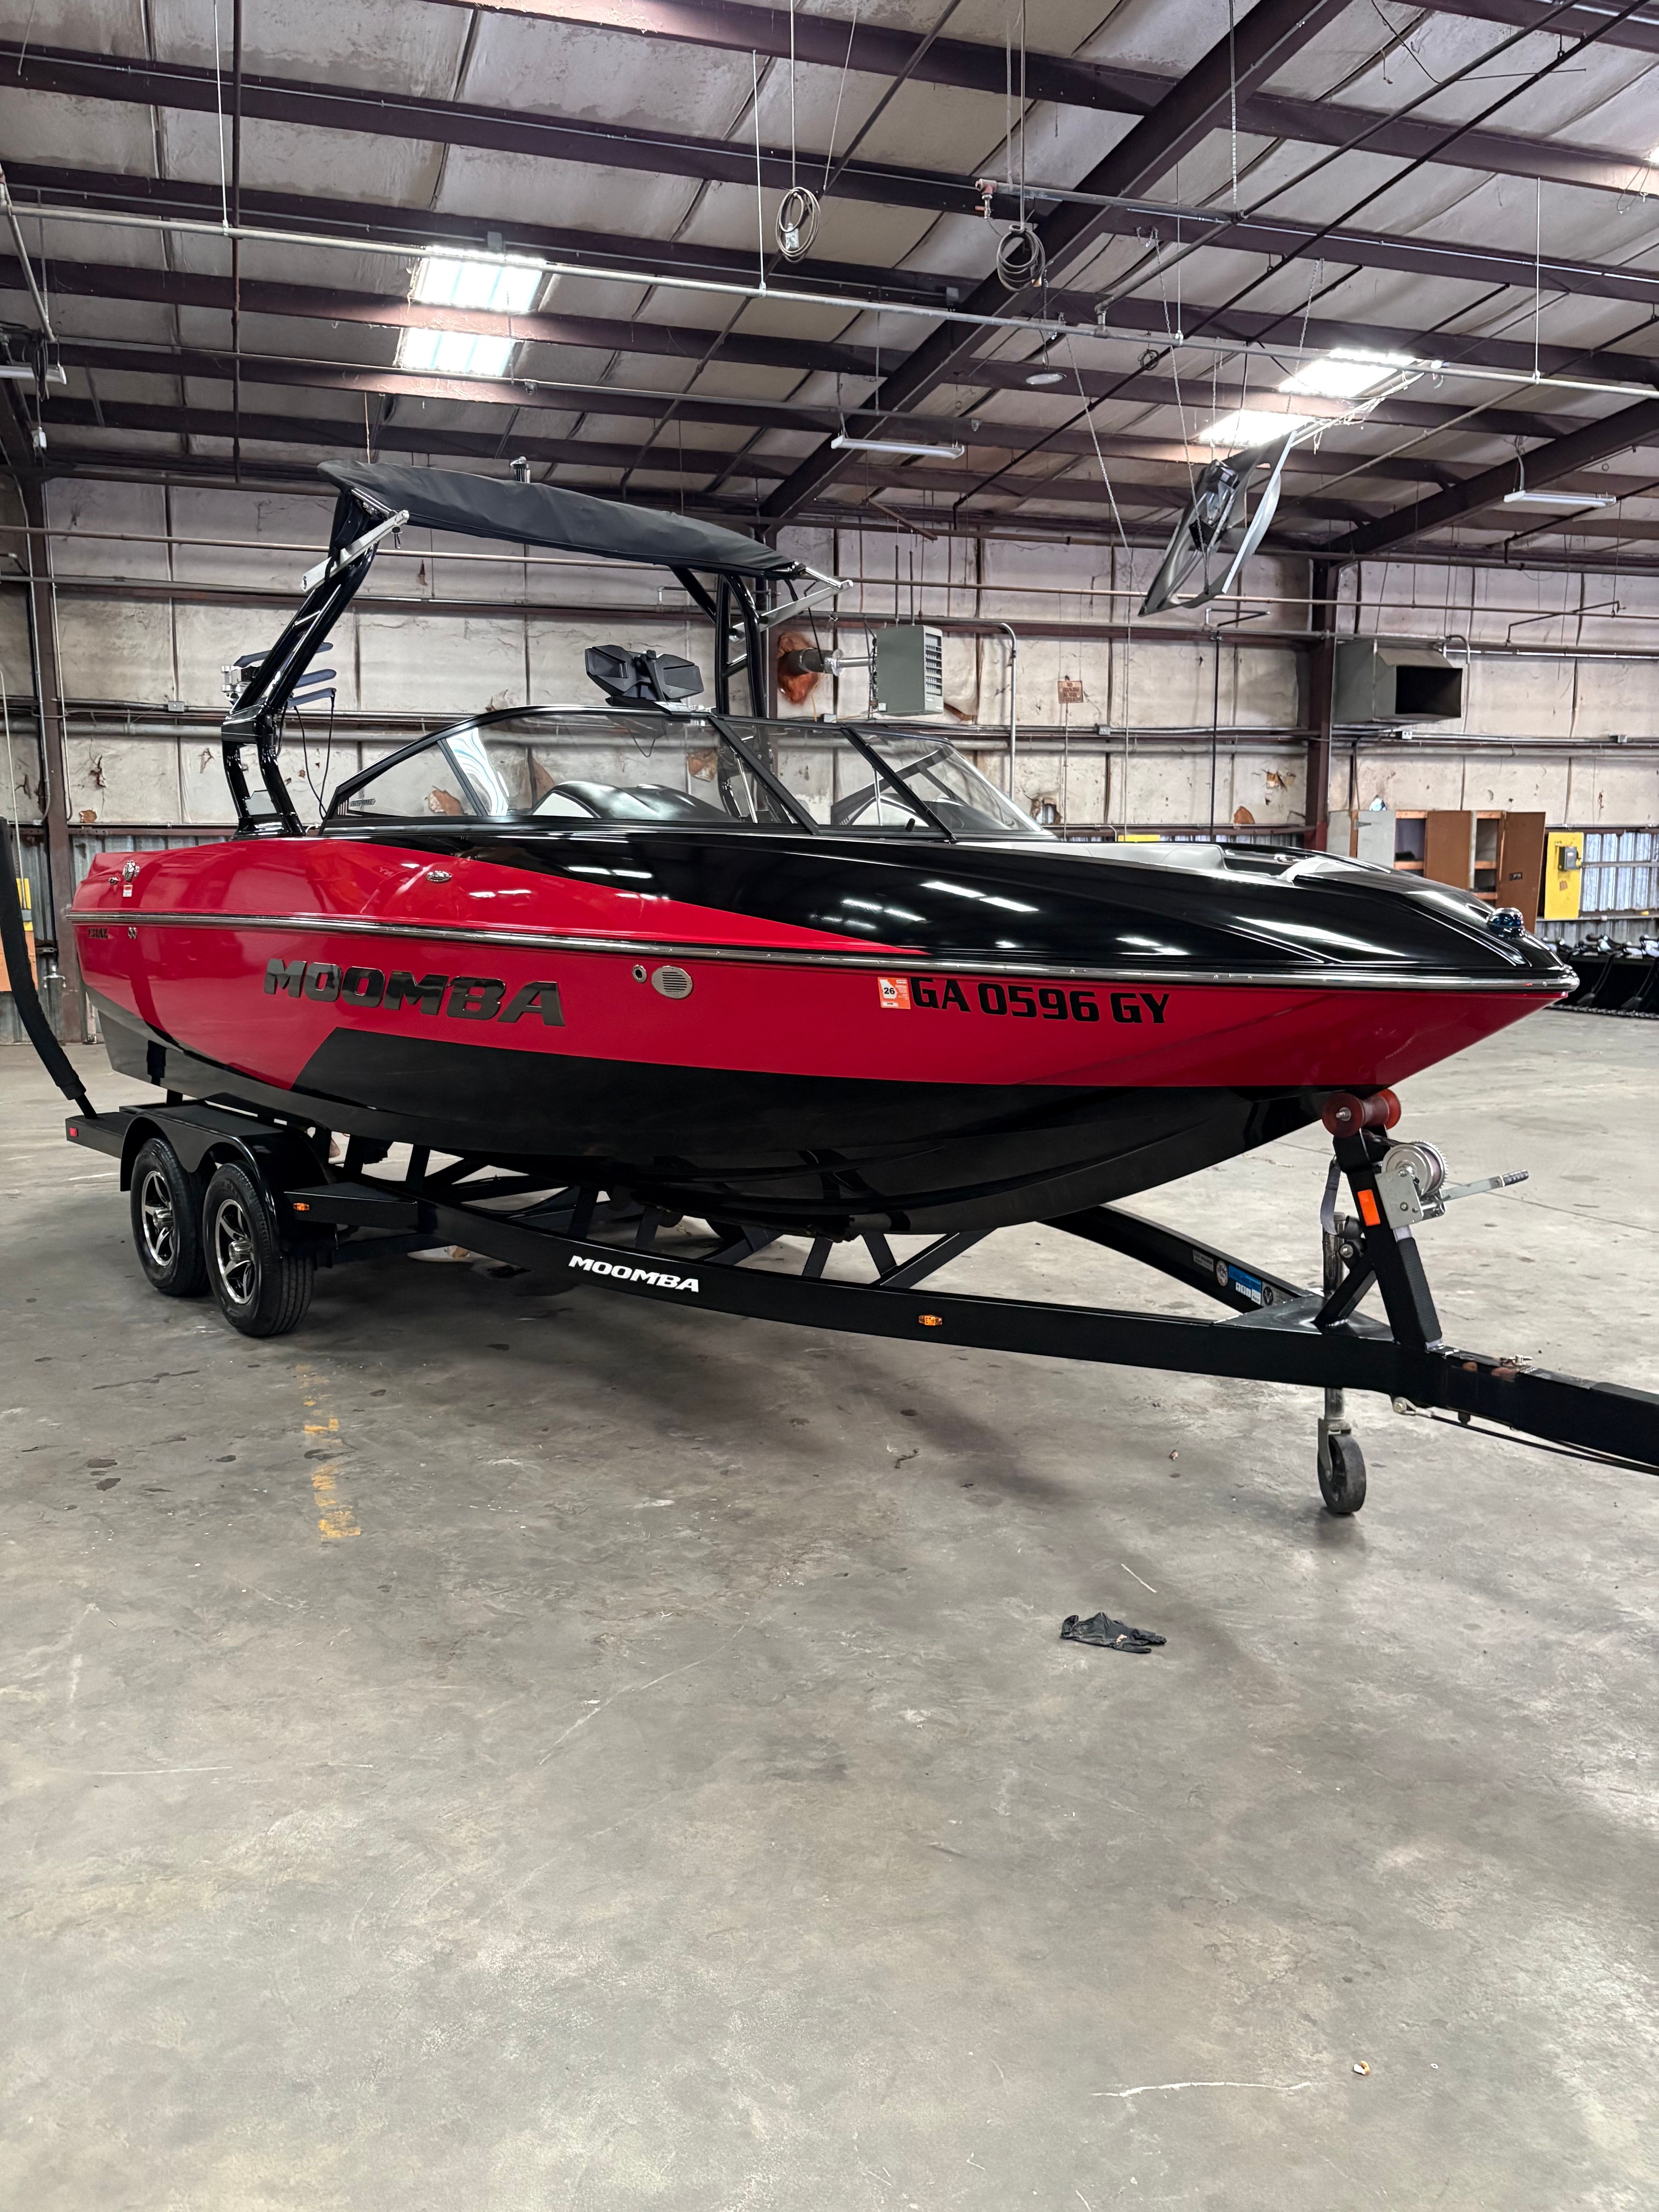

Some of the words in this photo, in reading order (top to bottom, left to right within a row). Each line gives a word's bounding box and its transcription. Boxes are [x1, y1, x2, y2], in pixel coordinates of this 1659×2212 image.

[263, 958, 565, 1027] MOOMBA
[910, 977, 972, 1012] GA
[977, 982, 1100, 1022] 0596
[1109, 992, 1170, 1024] GY
[568, 1255, 699, 1293] MOOMBA
